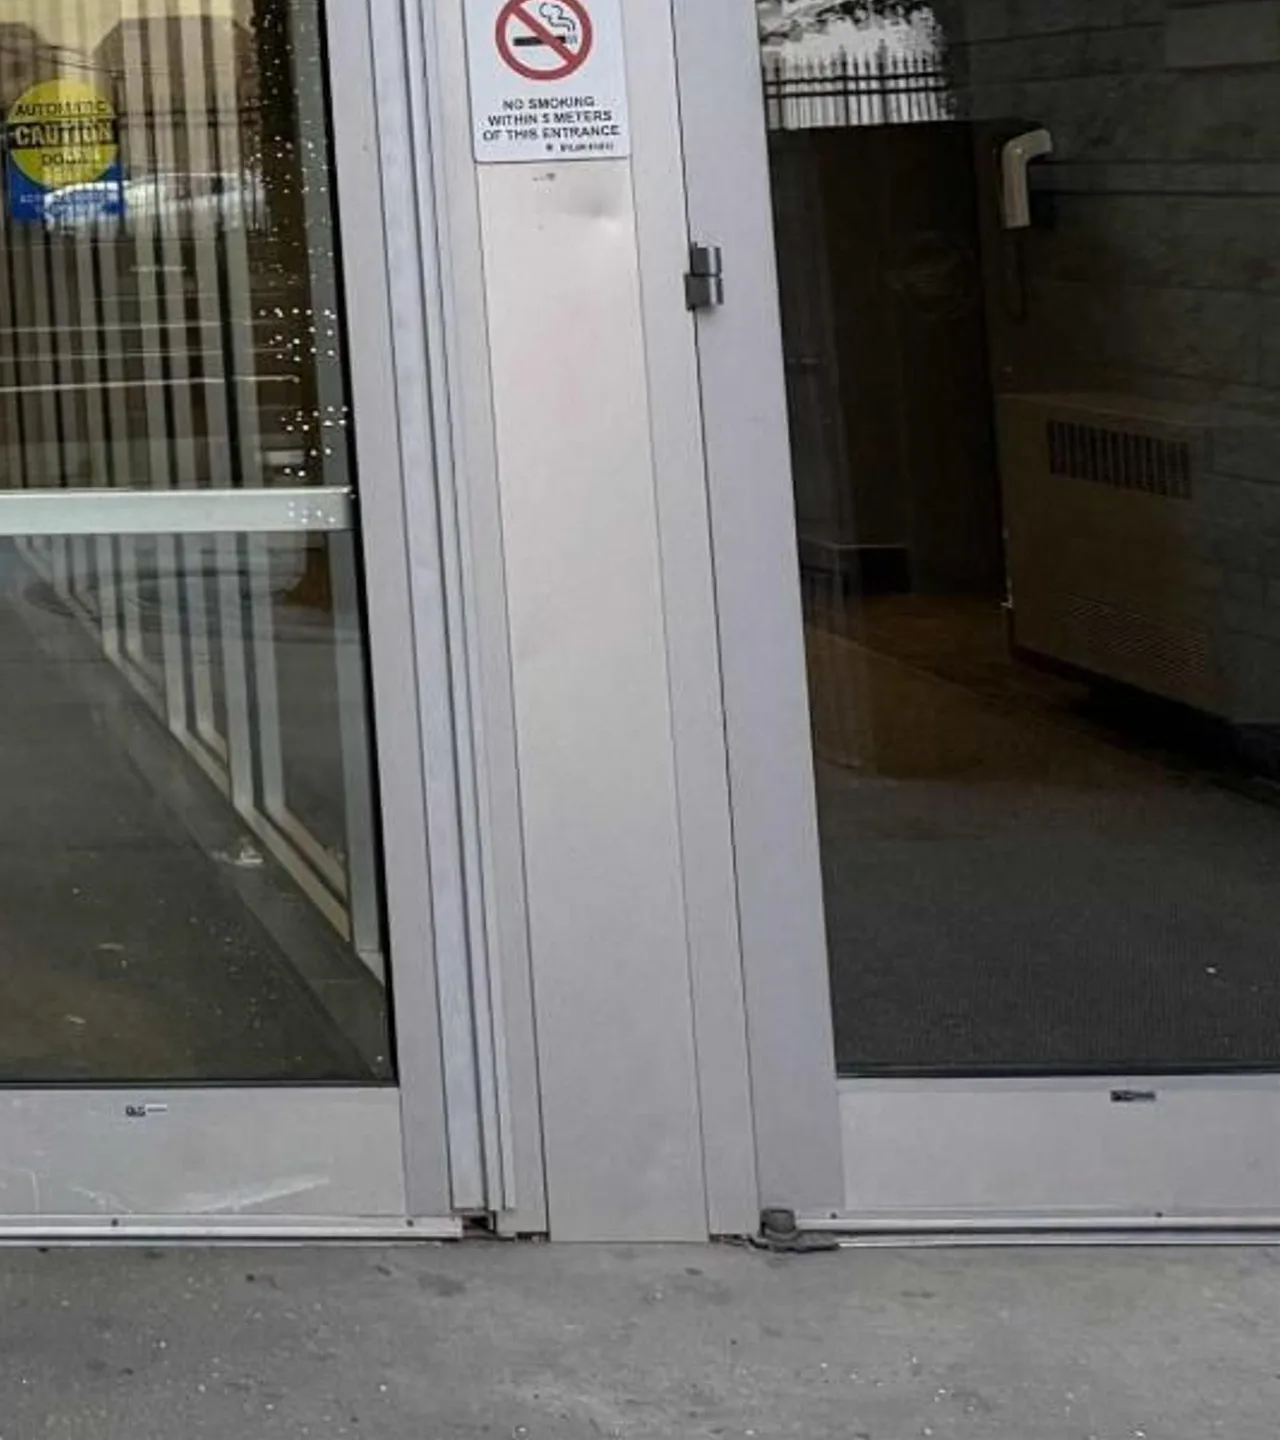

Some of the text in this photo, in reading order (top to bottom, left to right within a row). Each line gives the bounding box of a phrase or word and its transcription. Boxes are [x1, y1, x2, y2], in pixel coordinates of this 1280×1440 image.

[503, 96, 595, 110] NO SMOKING
[488, 110, 613, 126] WITHIN 5 METERS
[15, 121, 112, 145] CAUTION
[483, 125, 621, 141] OF THIS ENTRANCE
